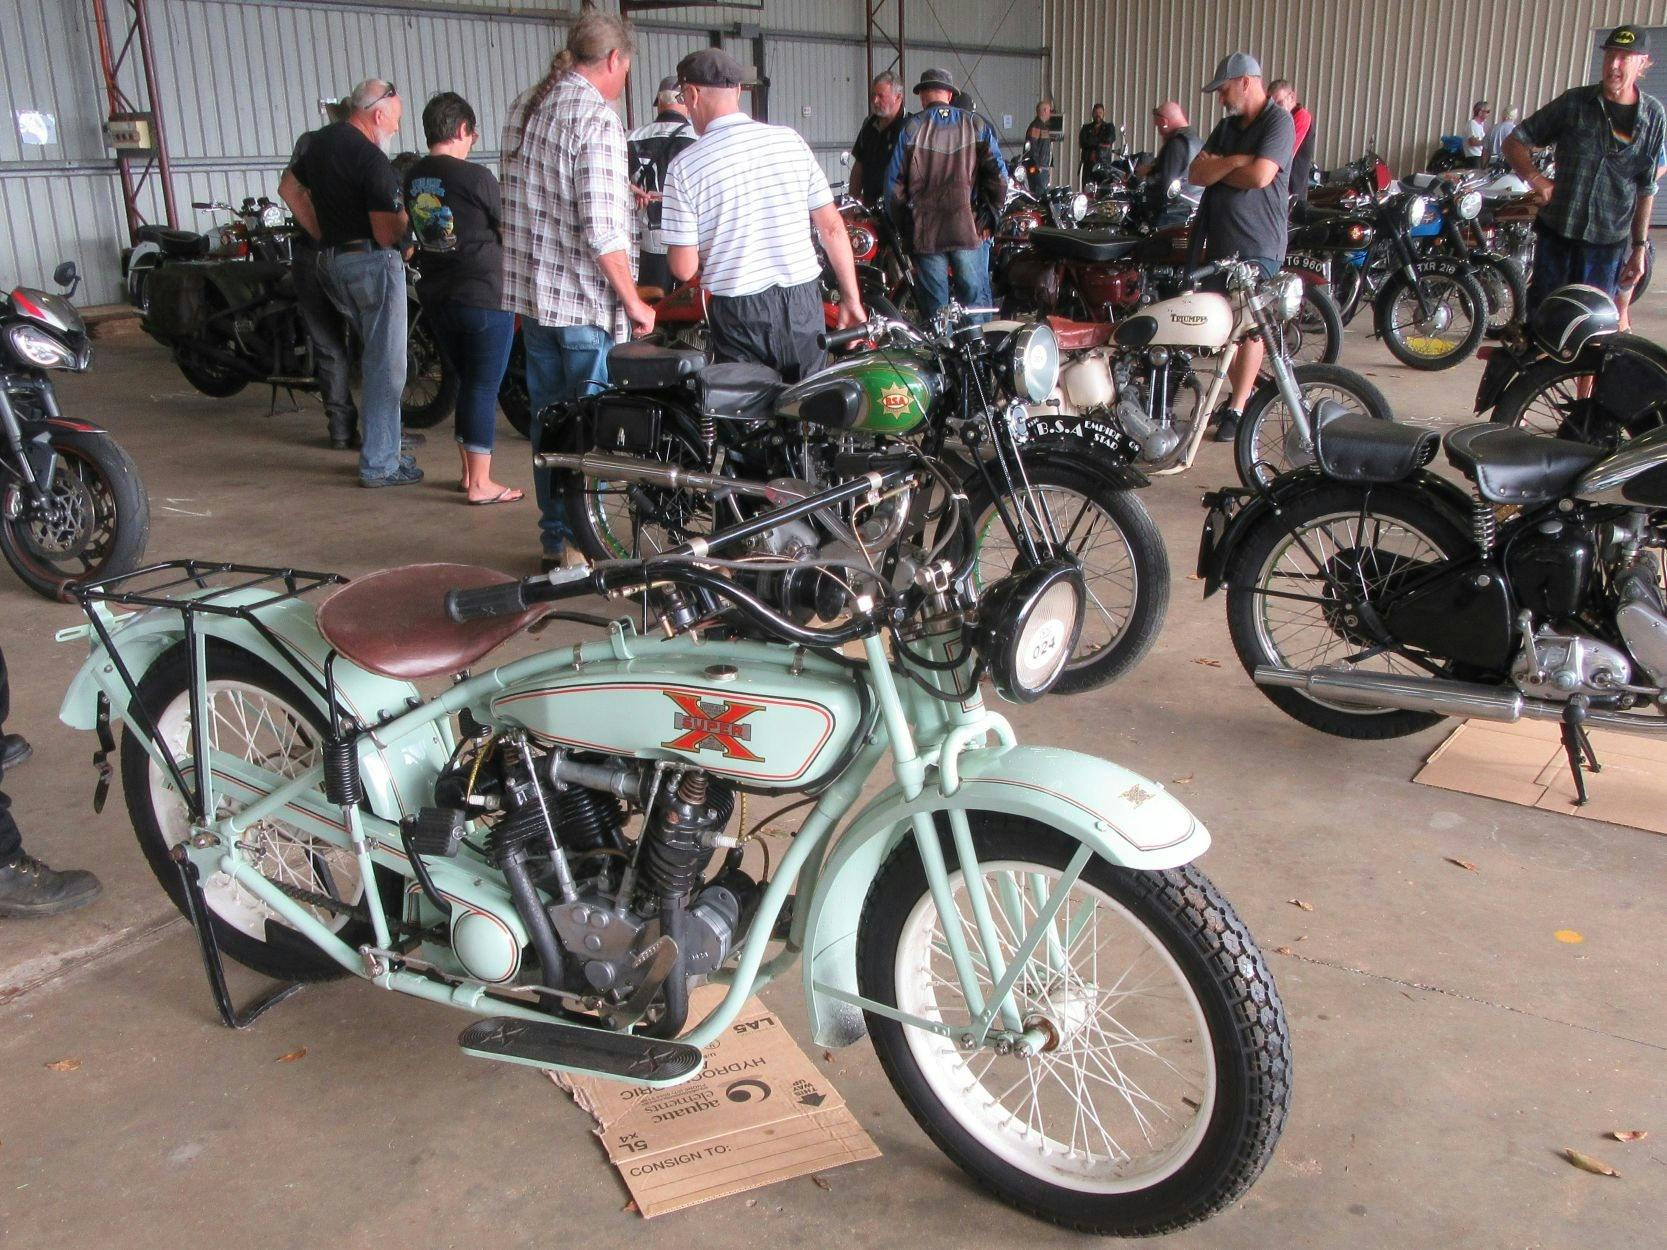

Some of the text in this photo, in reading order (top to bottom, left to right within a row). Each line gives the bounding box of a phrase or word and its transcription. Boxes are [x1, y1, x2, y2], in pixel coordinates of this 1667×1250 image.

[1286, 256, 1300, 266] TG
[1085, 420, 1122, 443] EMPIRE
[1094, 433, 1119, 451] STAR
[682, 716, 742, 736] SUPER
[793, 1083, 813, 1091] WAY
[793, 1087, 818, 1096] THIS
[645, 1090, 714, 1113] elements
[653, 1100, 720, 1124] aquatic
[618, 1140, 648, 1153] 5L
[630, 1145, 732, 1177] CONSIGN TO:
